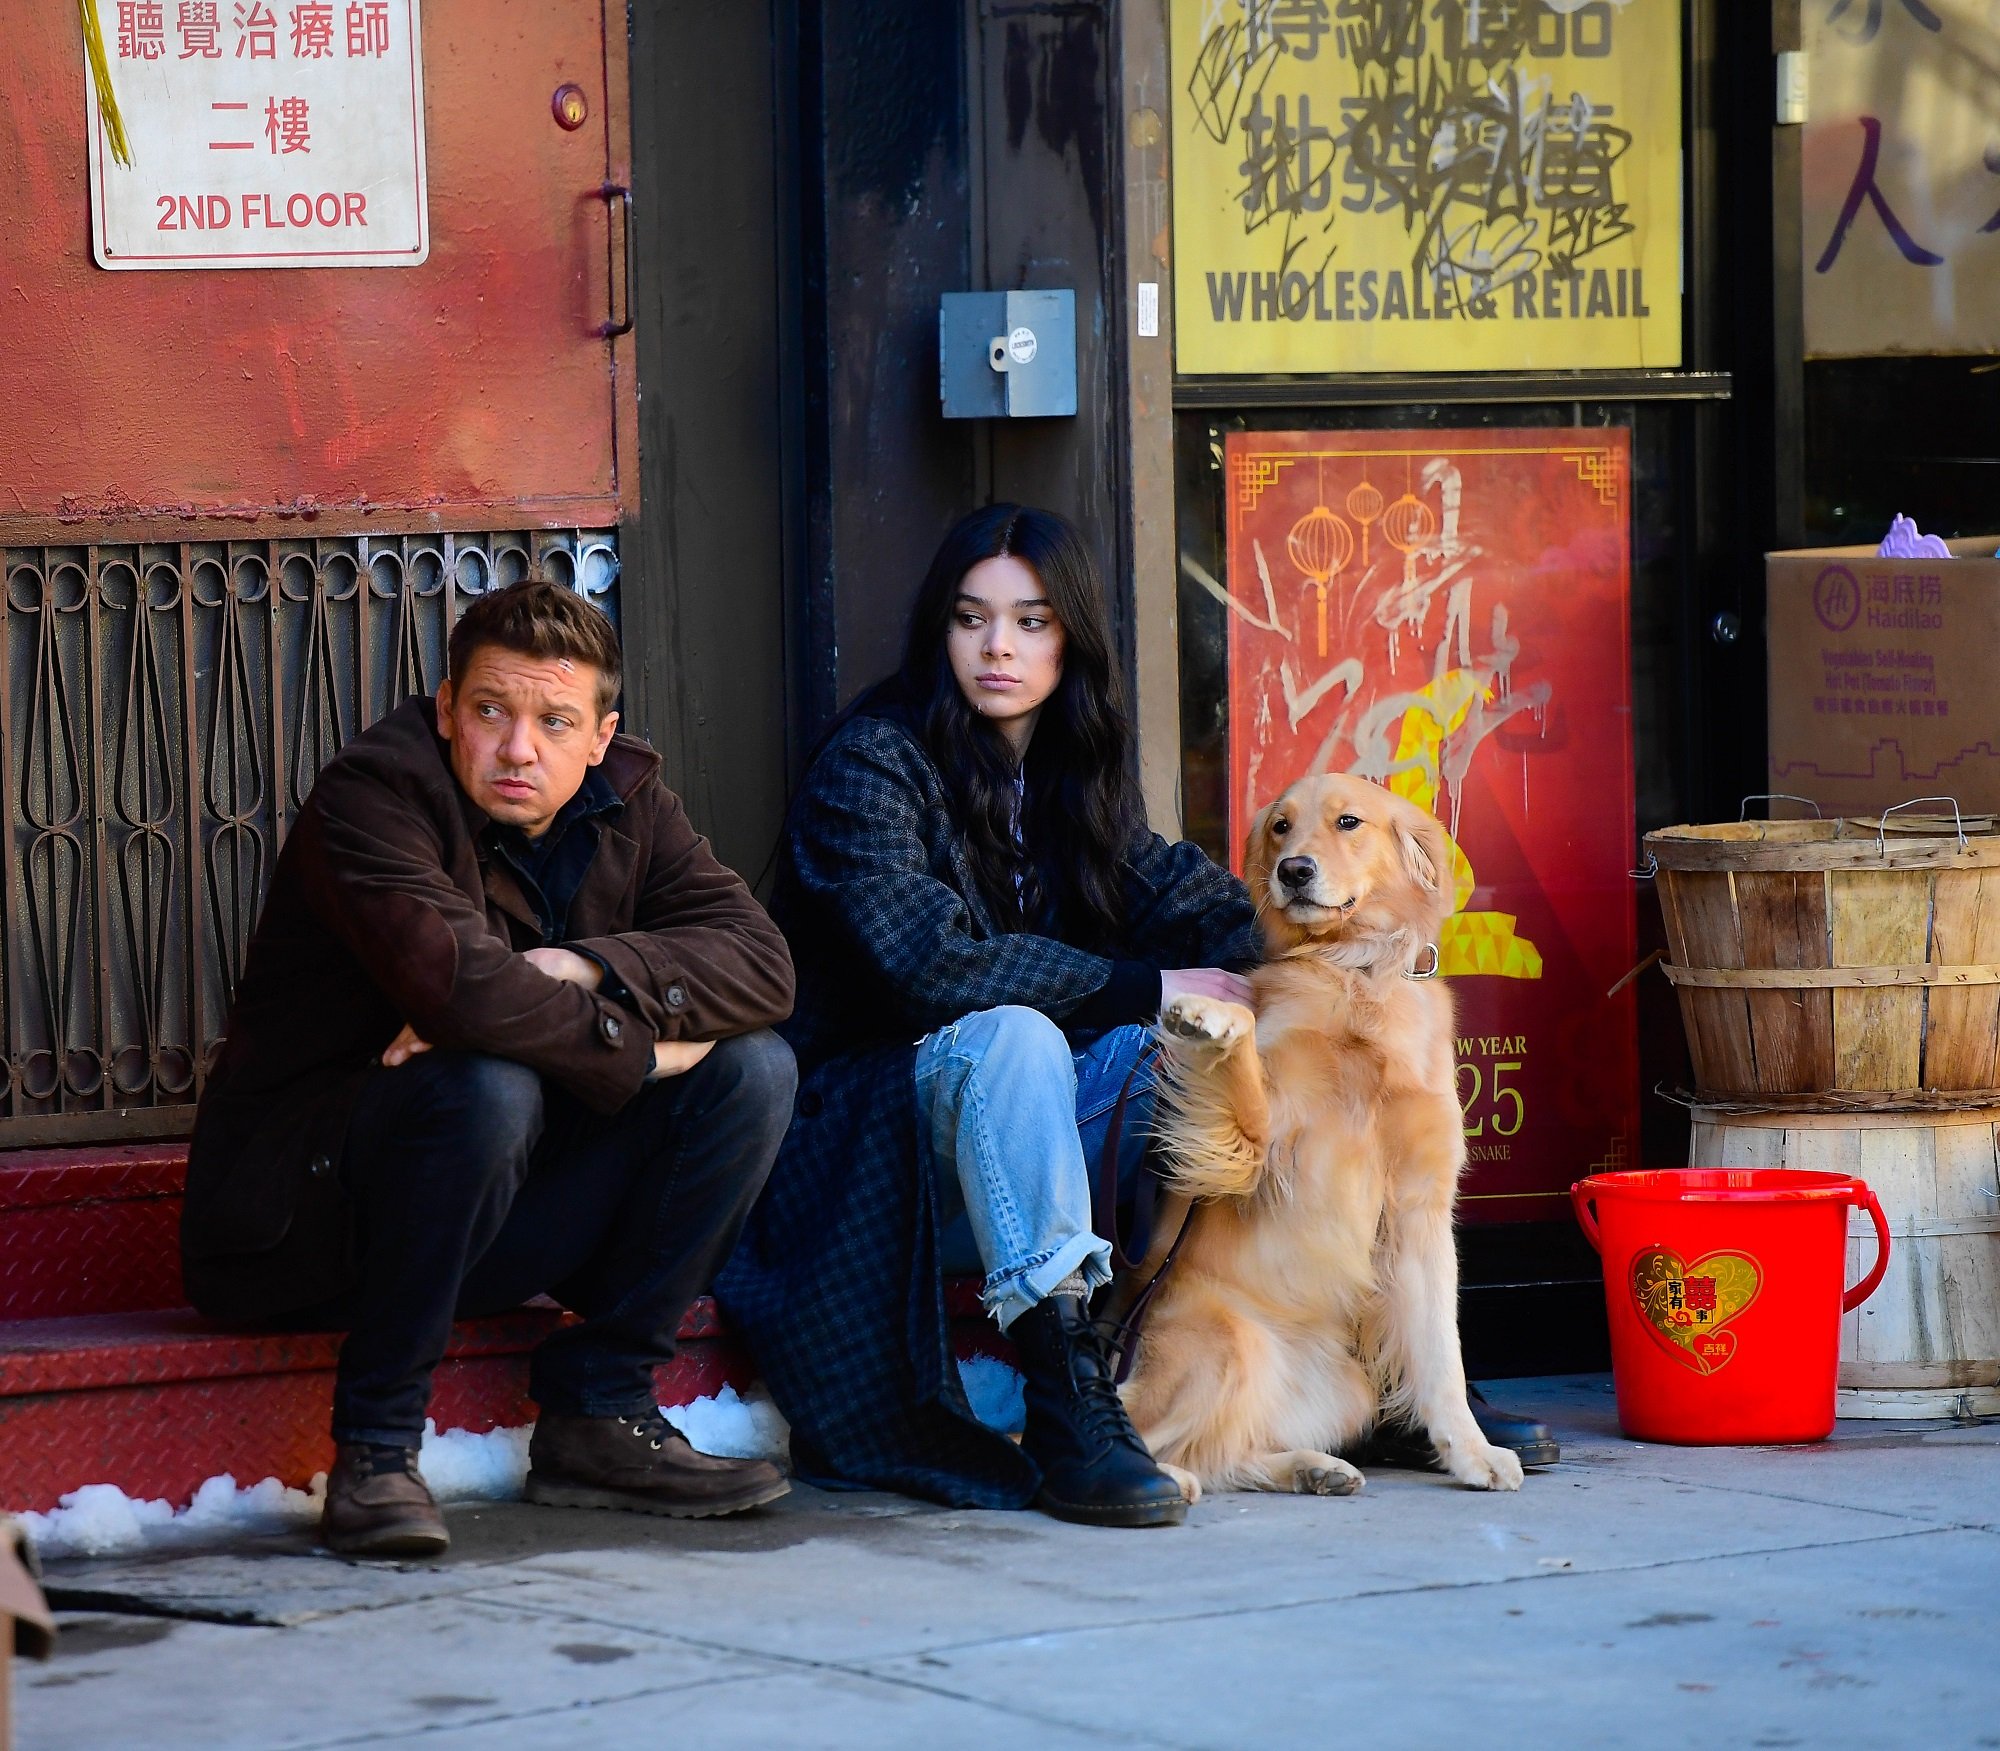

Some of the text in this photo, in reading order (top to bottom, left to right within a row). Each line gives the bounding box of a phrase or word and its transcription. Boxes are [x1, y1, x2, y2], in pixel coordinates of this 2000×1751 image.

[117, 1, 389, 60] 聽覺治療師
[208, 96, 311, 155] 二樓
[157, 192, 368, 231] 2ND FLOOR
[1206, 271, 1454, 321] WHOLESALE
[1468, 270, 1498, 320] &
[1513, 269, 1649, 319] RETAIL
[1867, 607, 1942, 629] Haidilao
[1478, 1035, 1527, 1056] YEAR
[1454, 1062, 1524, 1135] 25
[1471, 1144, 1511, 1161] SNAKE
